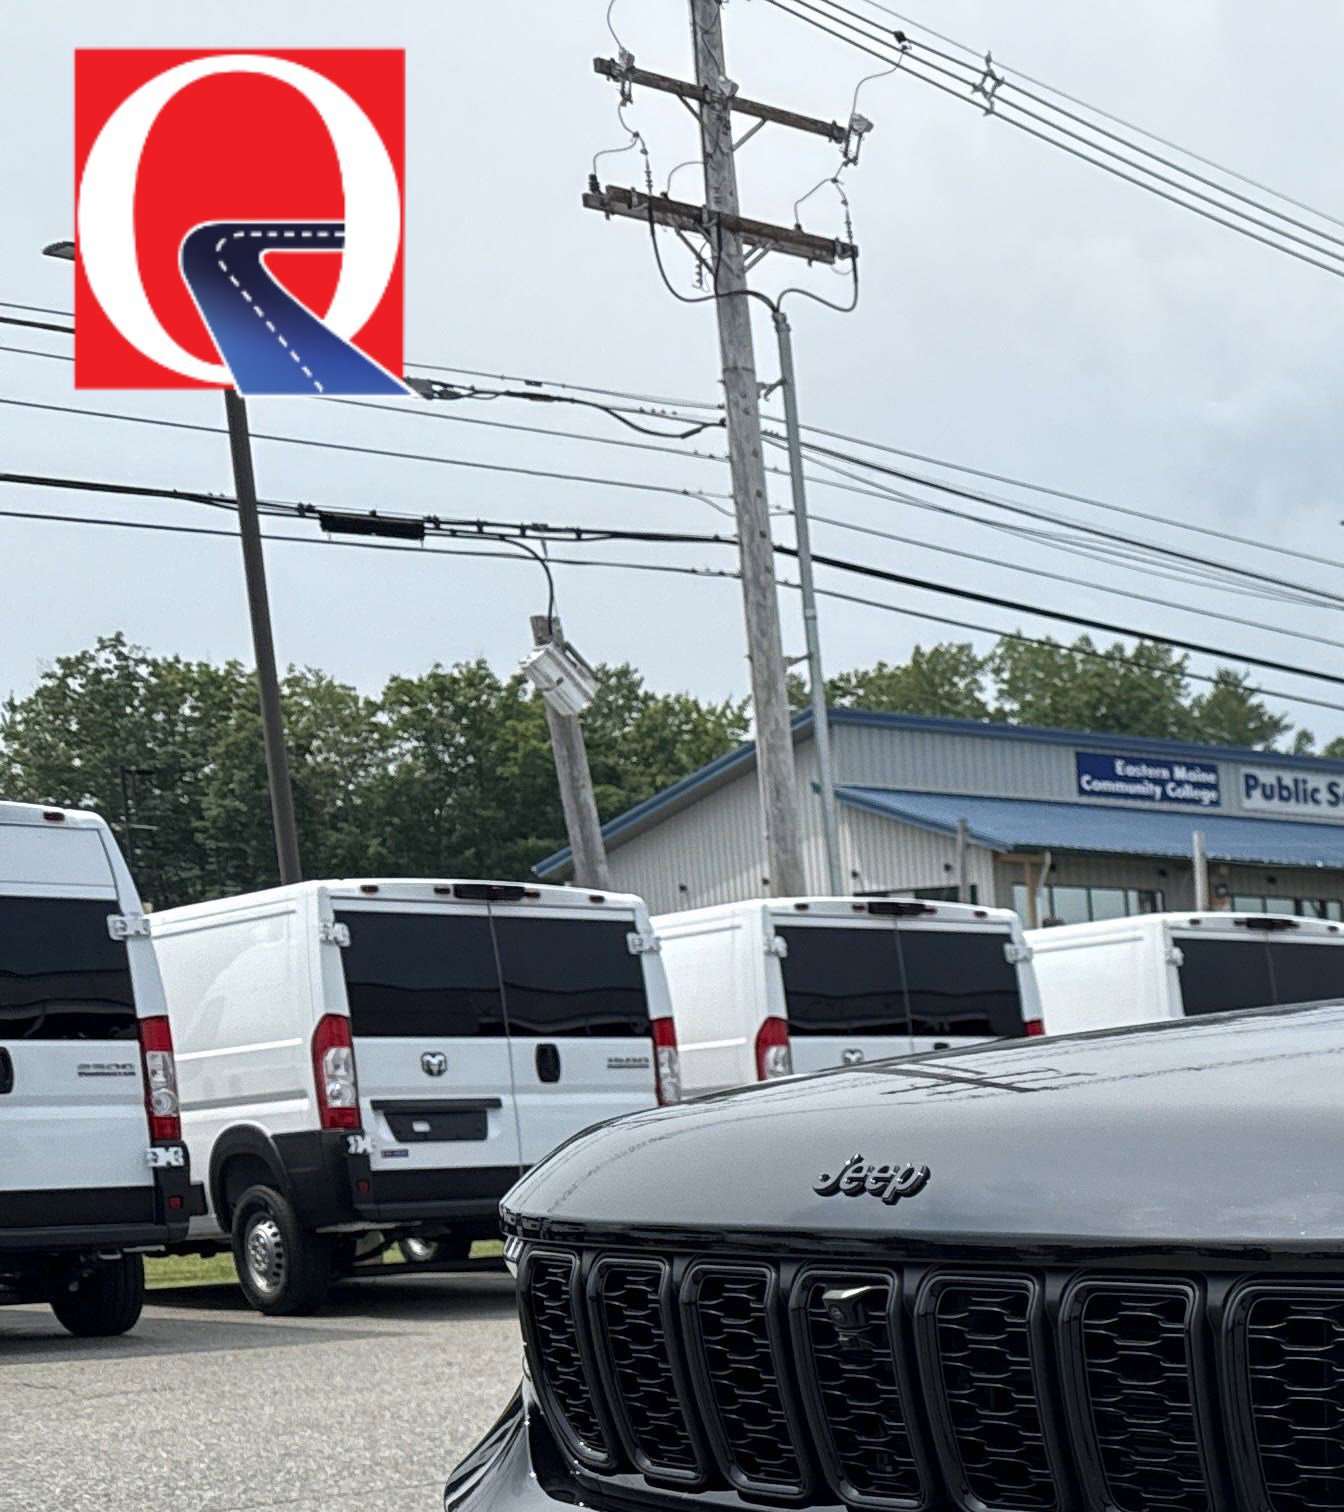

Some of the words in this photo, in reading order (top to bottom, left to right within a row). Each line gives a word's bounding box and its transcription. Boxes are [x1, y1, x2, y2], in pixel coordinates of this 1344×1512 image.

[1080, 774, 1163, 801] Community
[1166, 782, 1219, 805] College
[1244, 773, 1321, 806] Public
[812, 1153, 931, 1206] Jeep
